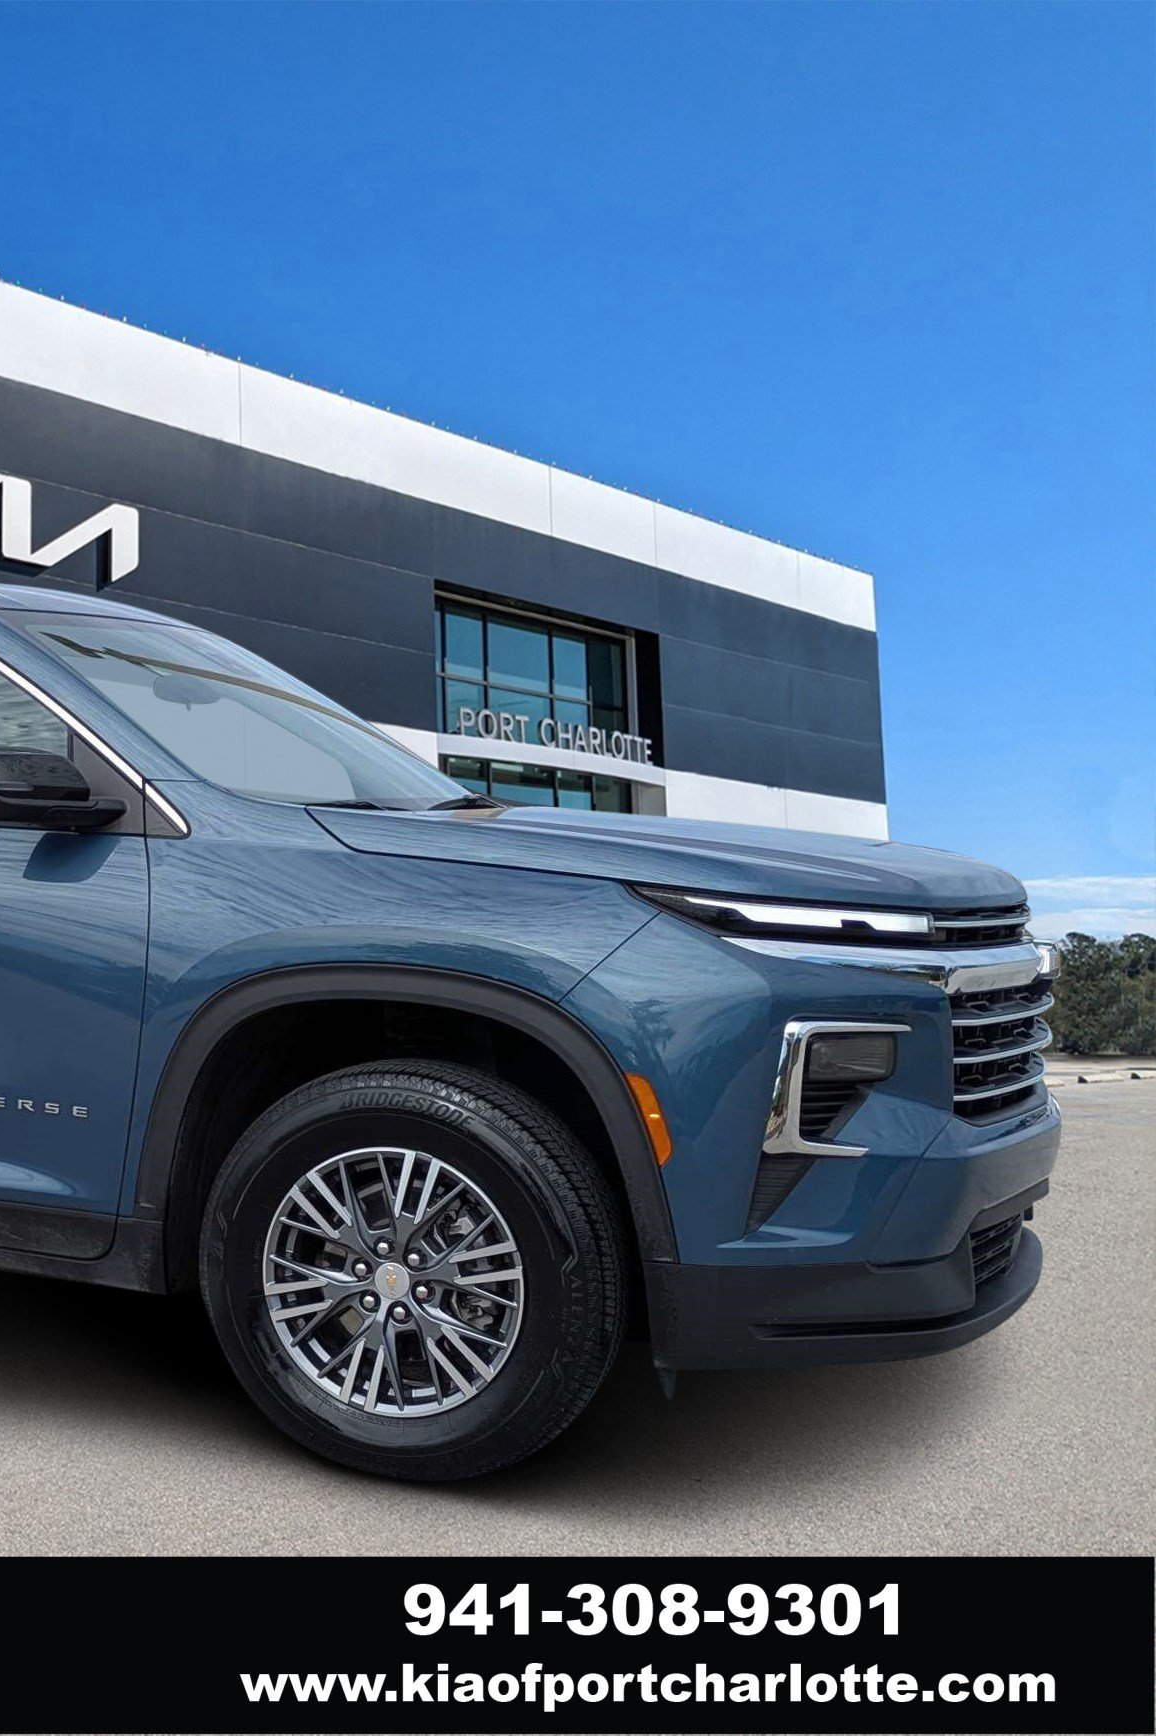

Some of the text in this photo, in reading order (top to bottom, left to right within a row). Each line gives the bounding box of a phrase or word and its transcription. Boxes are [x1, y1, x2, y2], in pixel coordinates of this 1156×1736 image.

[459, 707, 653, 764] PORT CHARLOTTE
[339, 1092, 476, 1128] BRIDGESTONE
